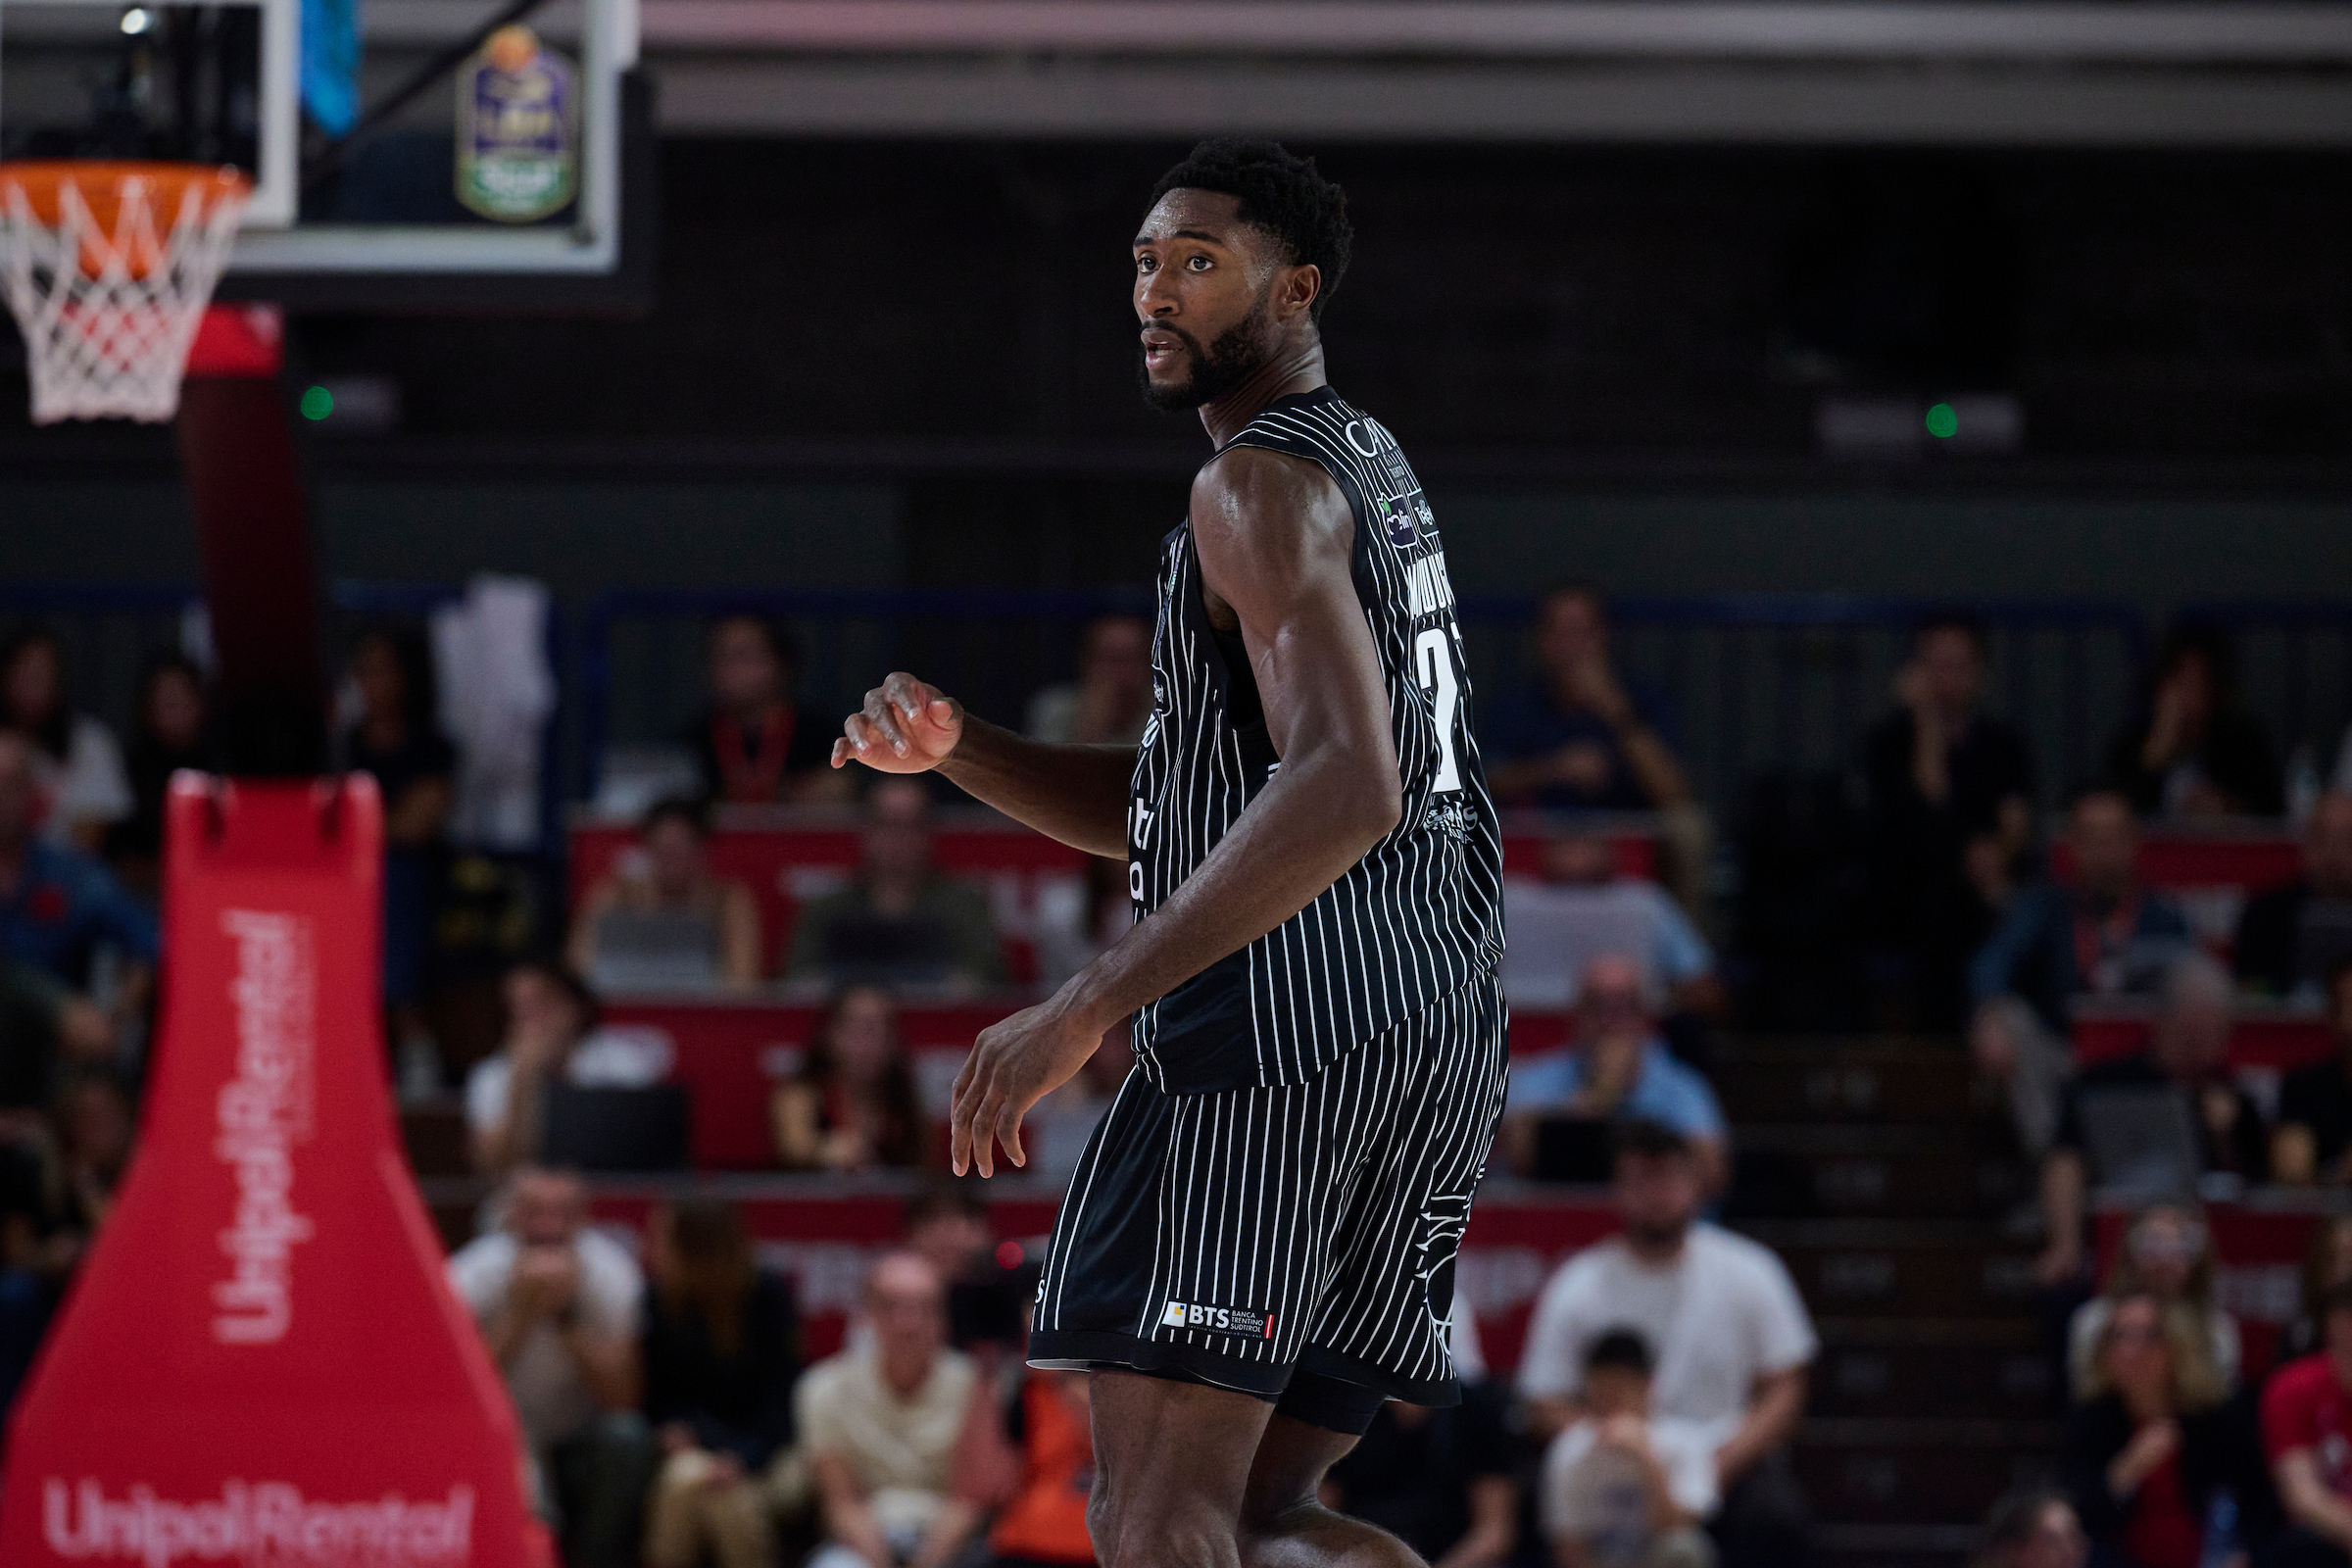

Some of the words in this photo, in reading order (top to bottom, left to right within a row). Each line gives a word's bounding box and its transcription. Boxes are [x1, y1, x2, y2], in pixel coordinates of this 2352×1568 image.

[1416, 623, 1461, 793] 2
[213, 909, 313, 1344] UnipolRental
[1189, 1304, 1229, 1328] BTS
[1231, 1316, 1263, 1326] TRENTINO
[1232, 1310, 1255, 1319] BANCA
[43, 1479, 473, 1568] UnipolRental
